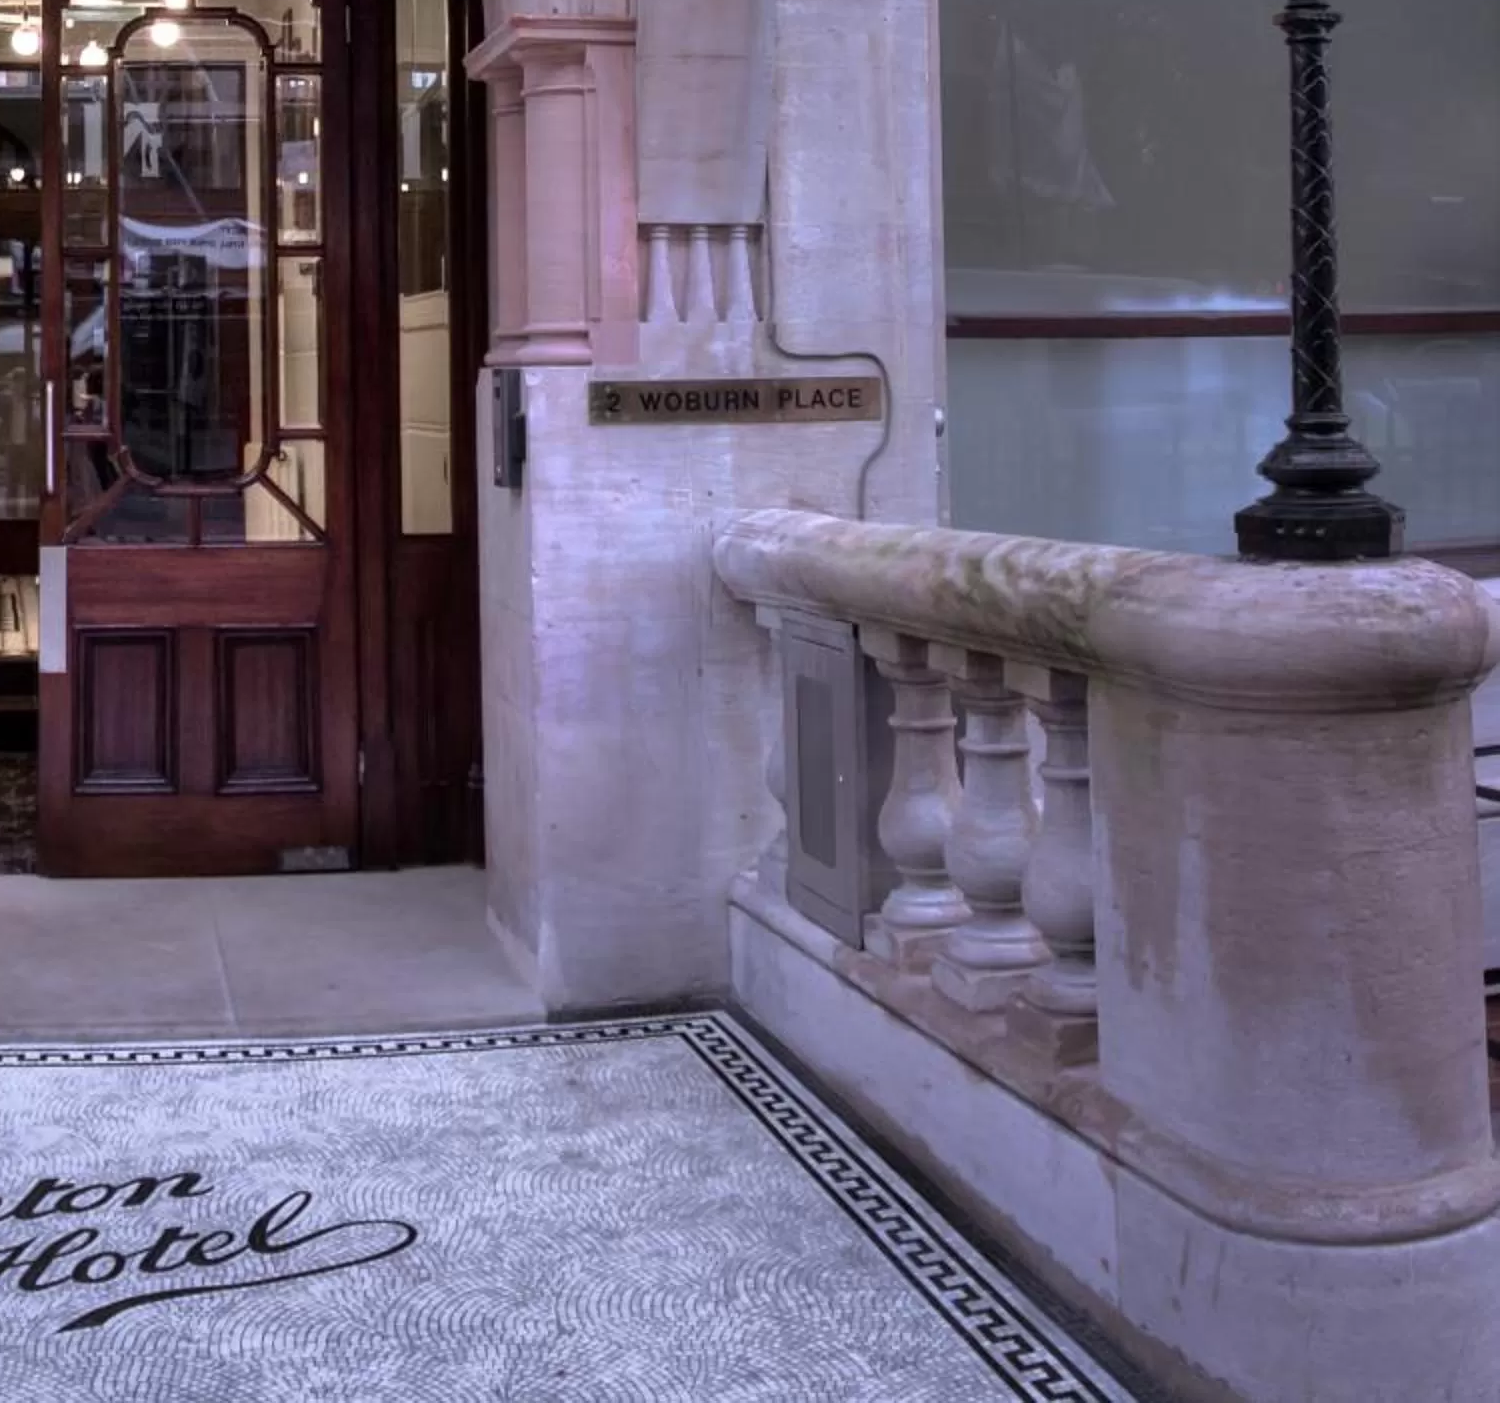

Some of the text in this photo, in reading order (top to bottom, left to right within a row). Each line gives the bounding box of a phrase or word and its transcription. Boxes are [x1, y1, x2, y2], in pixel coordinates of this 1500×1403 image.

[607, 387, 863, 413] 2 WOBURN PLACE
